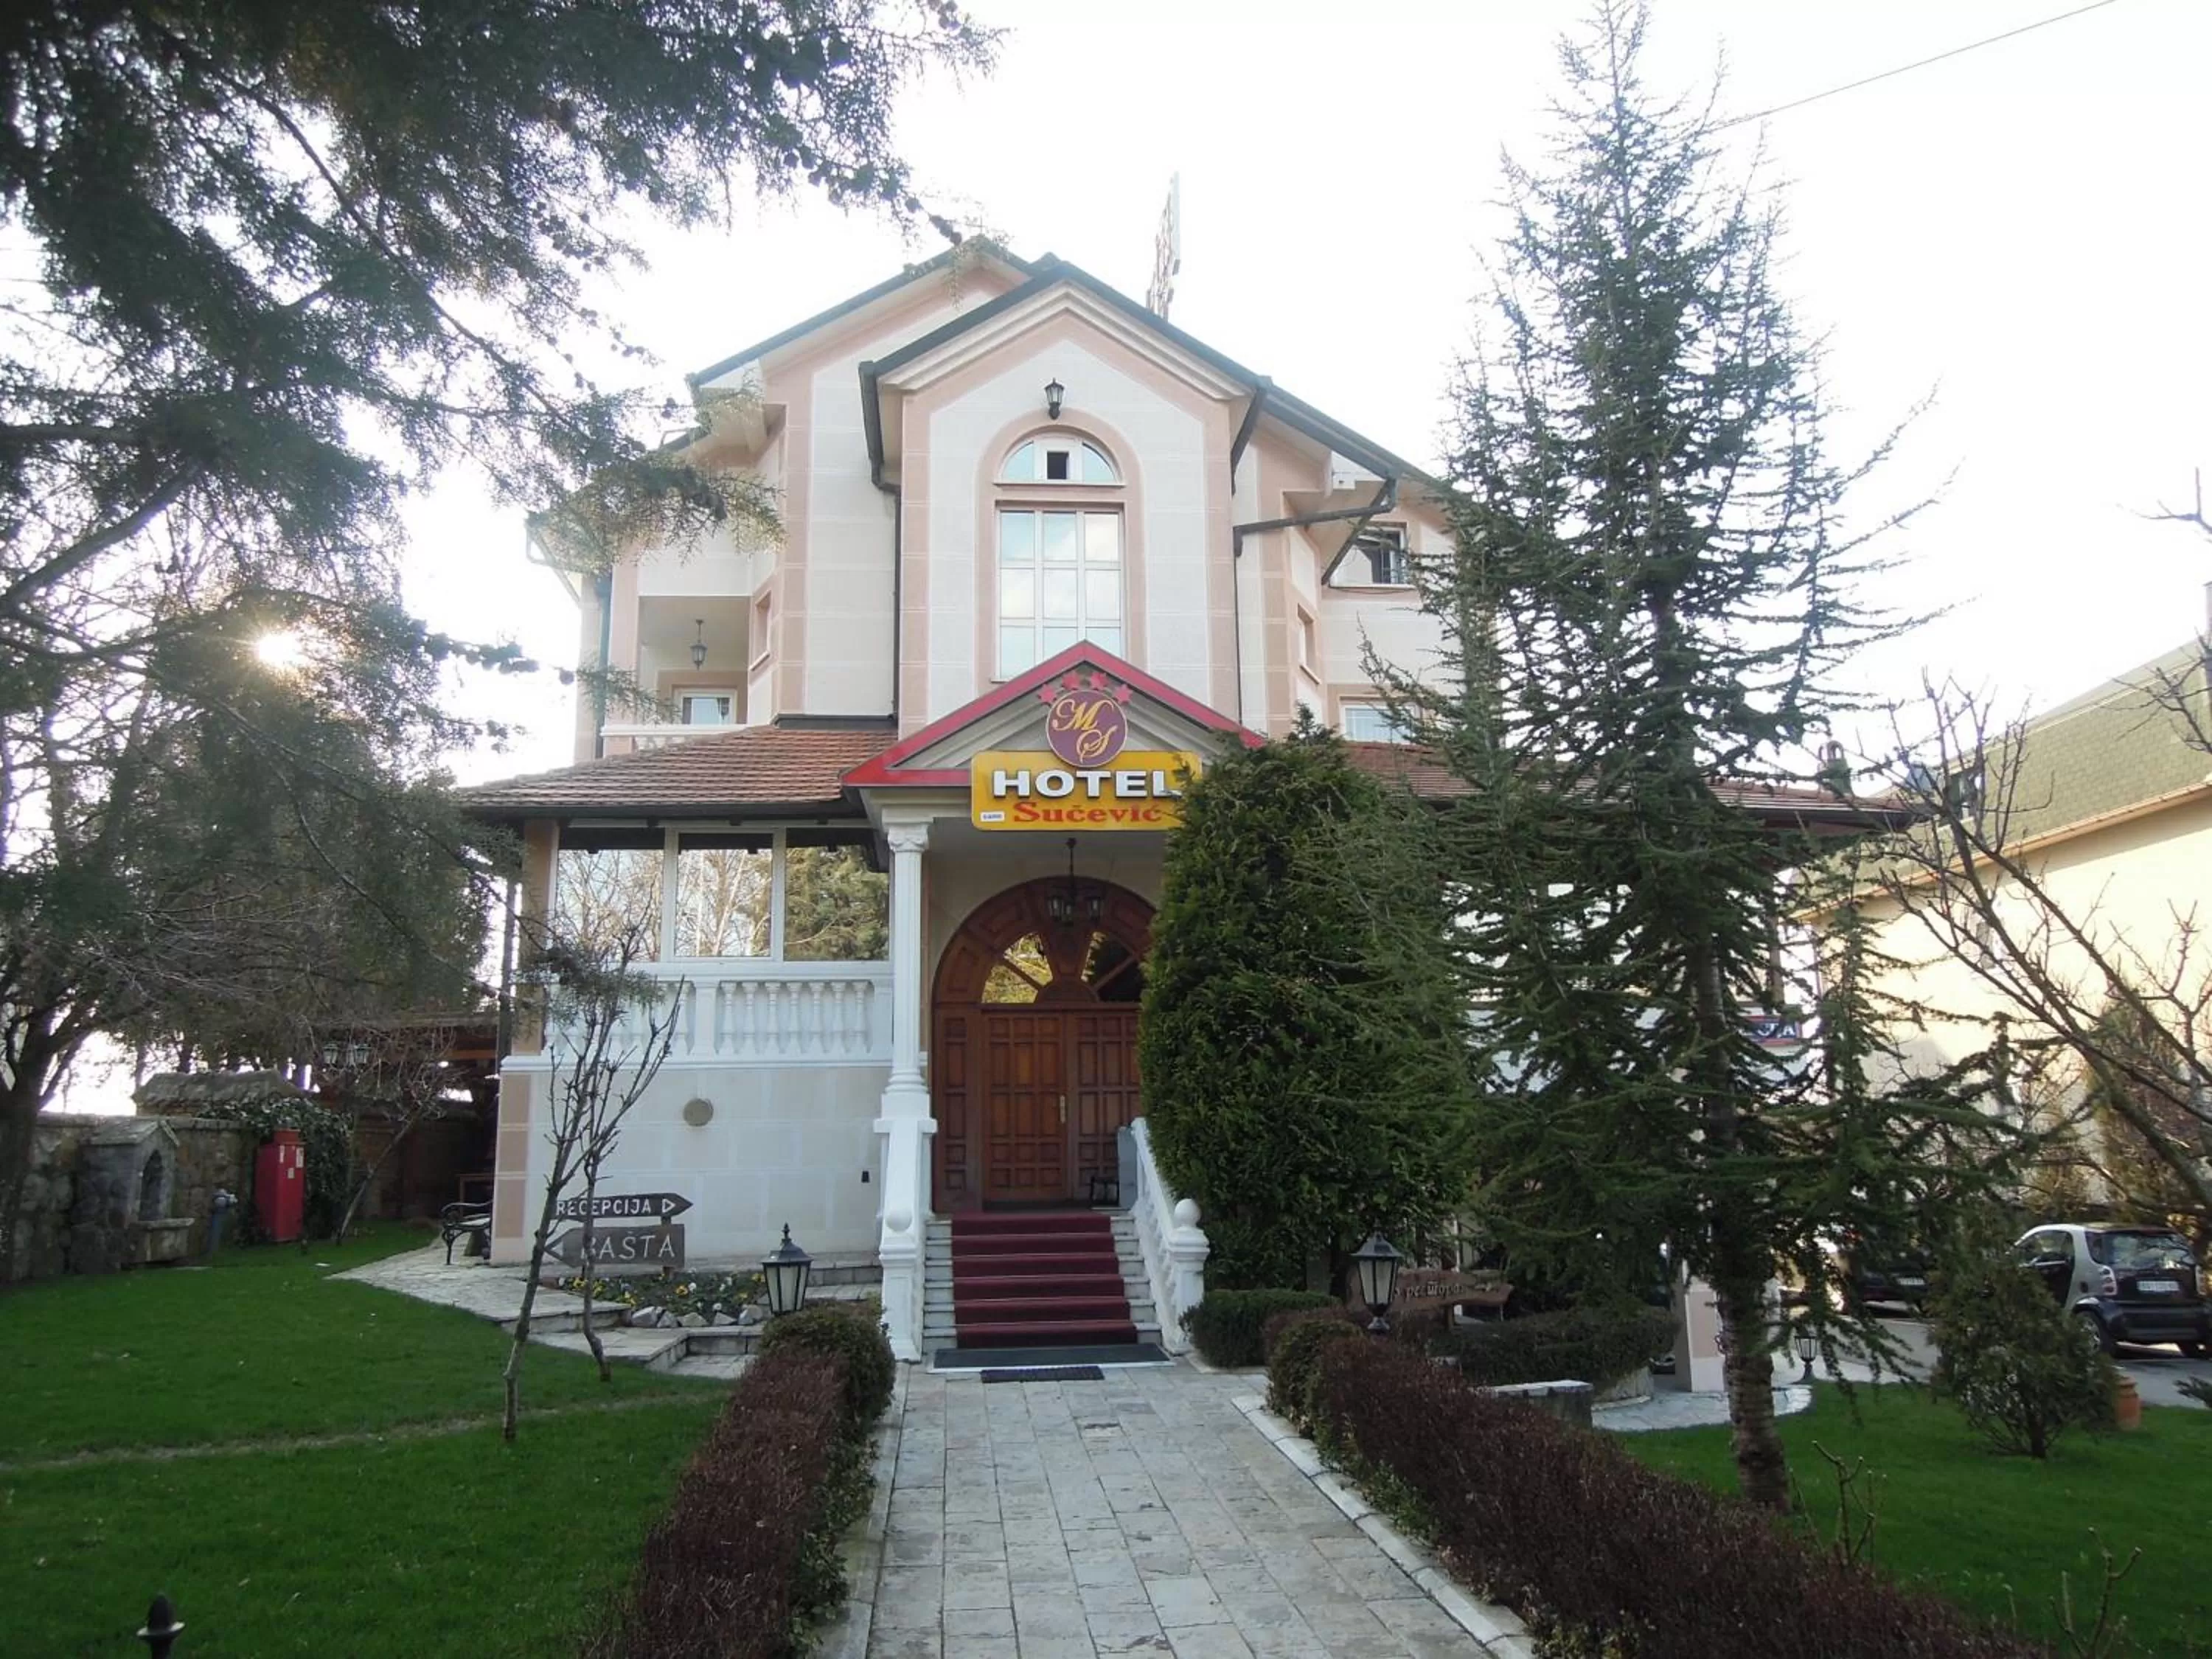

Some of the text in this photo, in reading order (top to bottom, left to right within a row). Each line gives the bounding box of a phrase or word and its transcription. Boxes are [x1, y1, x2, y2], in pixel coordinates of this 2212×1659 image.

[992, 769, 1183, 799] HOTEL
[1013, 801, 1164, 823] Sučević
[555, 1198, 651, 1216] RECEPCIJA
